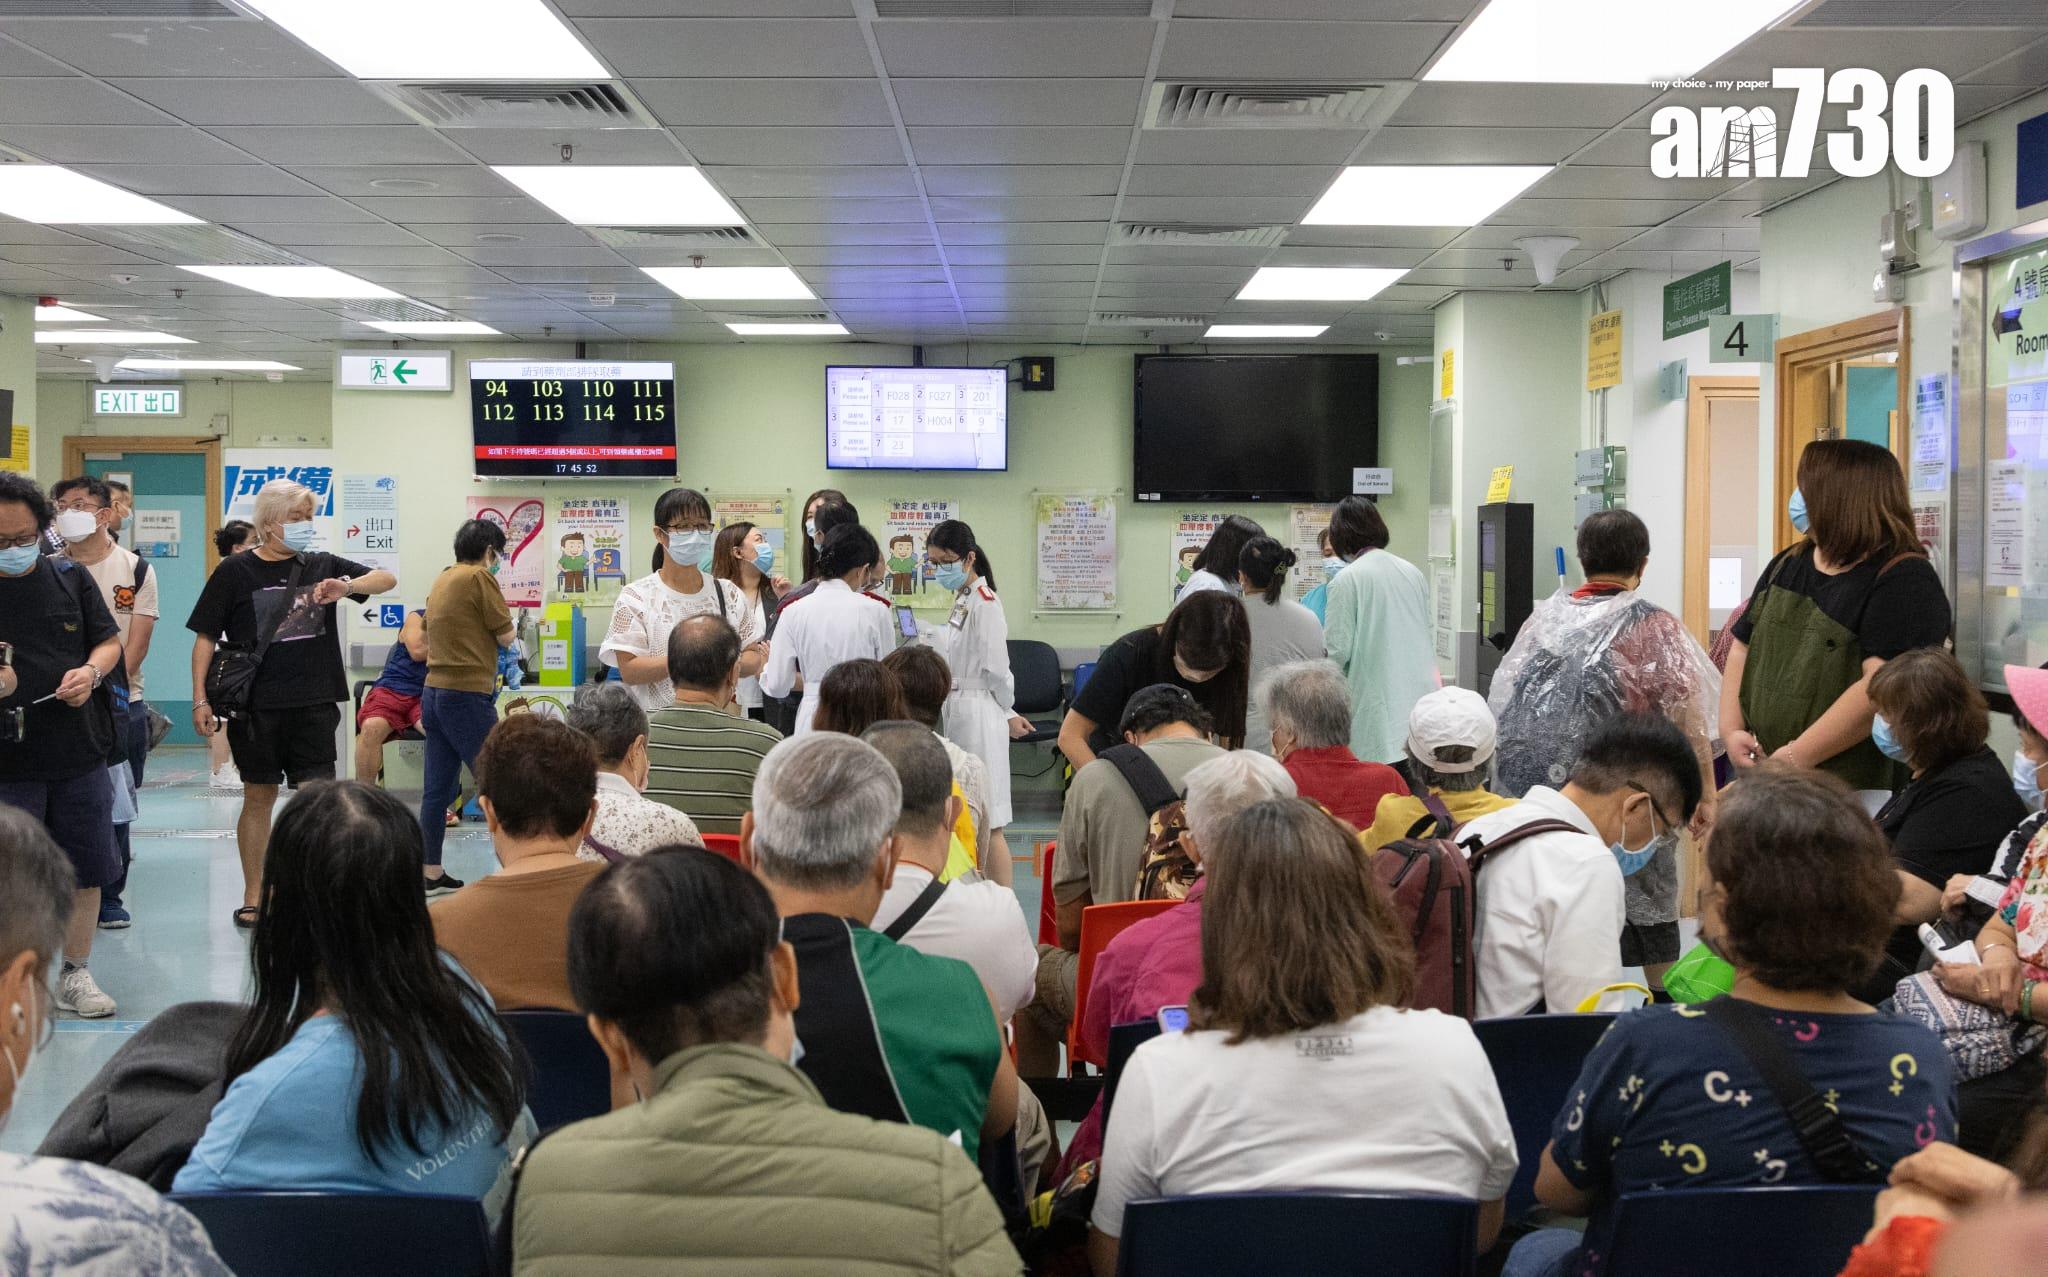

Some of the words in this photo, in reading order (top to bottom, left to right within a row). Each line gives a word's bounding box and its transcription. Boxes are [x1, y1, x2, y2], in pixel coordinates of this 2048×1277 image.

[2014, 276, 2022, 297] 4
[1724, 321, 1748, 356] 4
[1679, 364, 1684, 394] 1
[486, 381, 508, 397] 94
[532, 381, 563, 397] 103
[583, 381, 614, 397] 110
[633, 381, 663, 397] 111
[887, 392, 910, 401] F028
[917, 390, 923, 399] 2
[929, 392, 952, 401] F027
[959, 390, 964, 399] 3
[973, 391, 990, 402] 201
[101, 393, 138, 412] EXIT
[145, 393, 175, 412] 出口
[483, 404, 514, 421] 112
[533, 404, 564, 421] 113
[584, 404, 615, 421] 114
[634, 404, 665, 421] 115
[875, 415, 881, 423] 4
[917, 415, 922, 424] 5
[927, 416, 952, 425] H004
[959, 416, 964, 424] 6
[876, 439, 881, 448] 7
[892, 441, 904, 450] 23
[556, 464, 566, 473] 17
[571, 464, 582, 473] 45
[586, 464, 597, 473] 52
[922, 502, 947, 510] 心平靜
[890, 511, 950, 520] 血壓度數最真正
[366, 517, 393, 532] 出口
[1180, 523, 1216, 531] 血壓度數
[366, 536, 393, 549] Exit
[602, 551, 612, 566] 5
